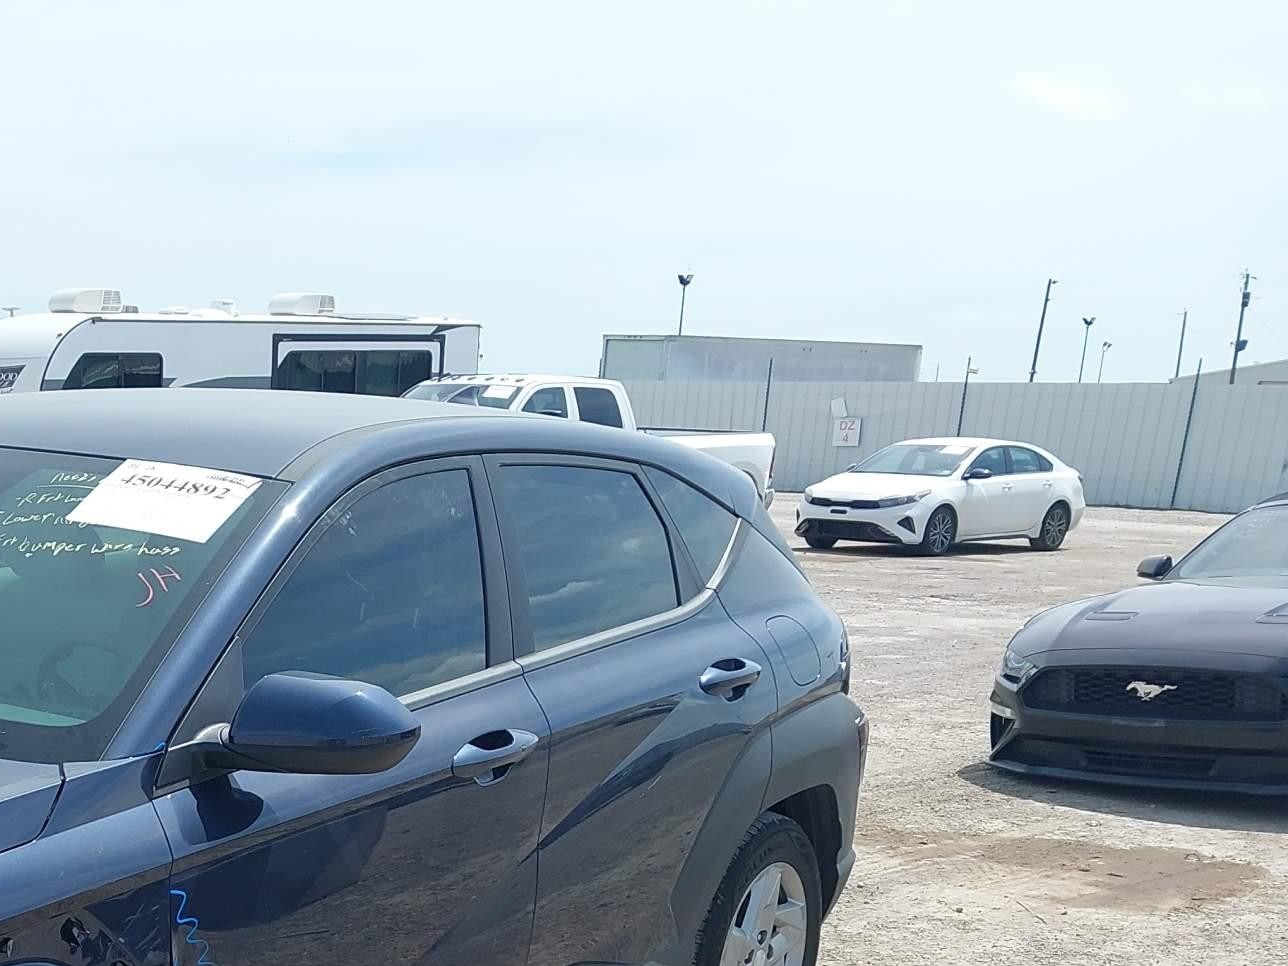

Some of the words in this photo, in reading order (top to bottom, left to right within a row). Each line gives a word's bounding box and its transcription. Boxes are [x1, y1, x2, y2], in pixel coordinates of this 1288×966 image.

[839, 420, 857, 431] DZ
[842, 432, 849, 443] 4
[121, 473, 231, 500] 45044892
